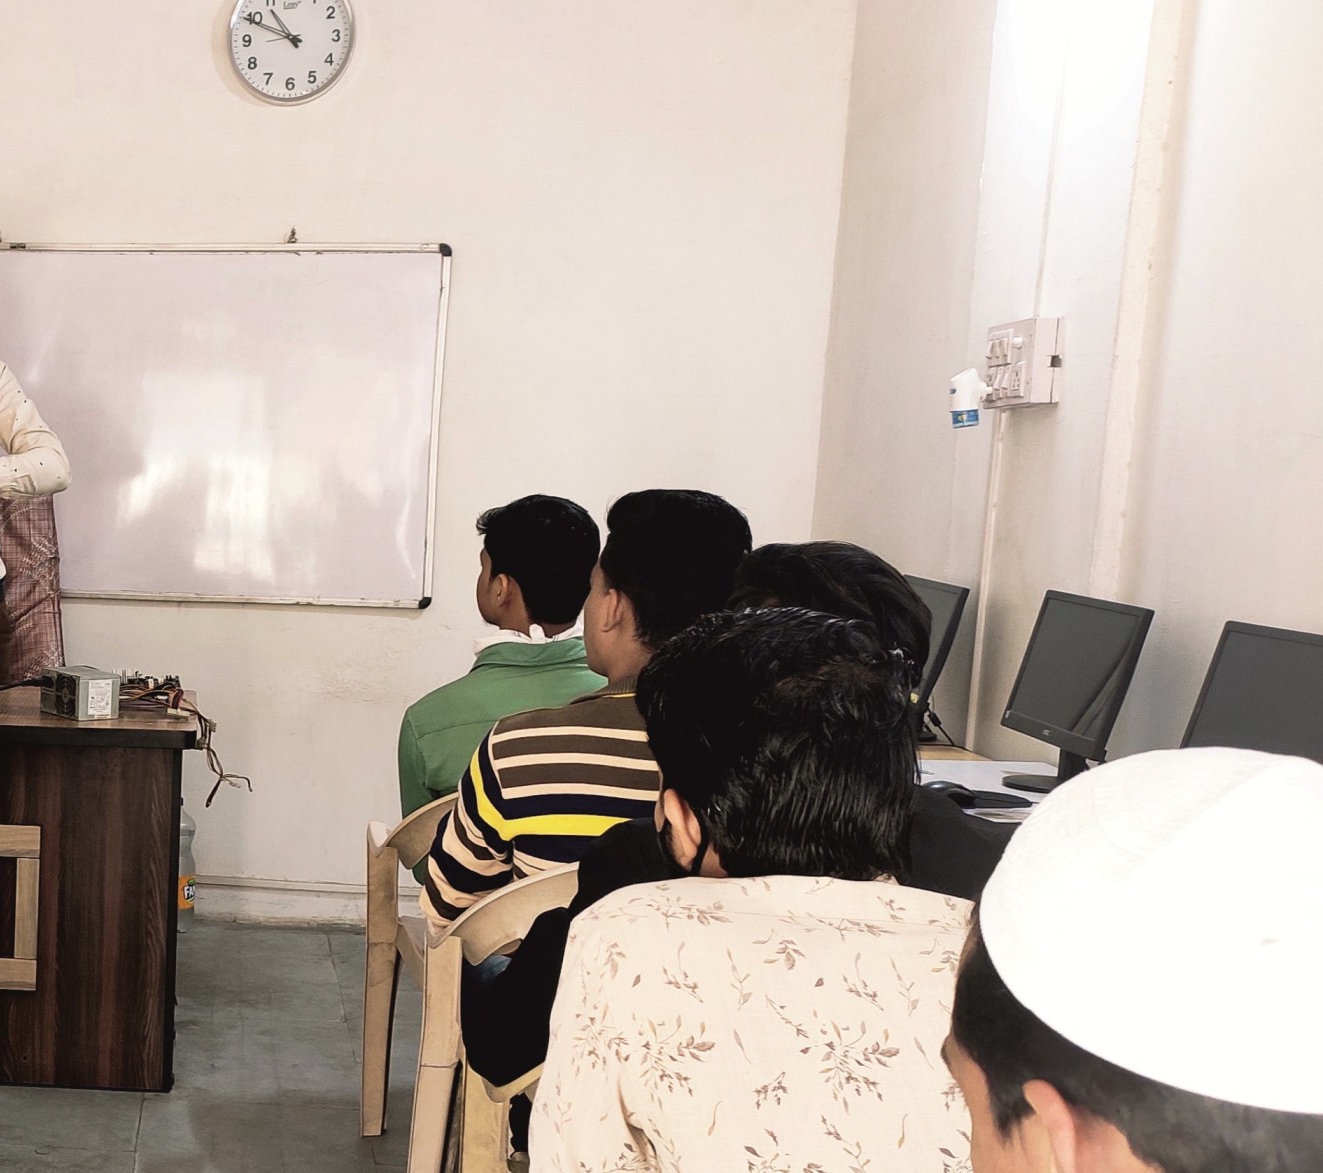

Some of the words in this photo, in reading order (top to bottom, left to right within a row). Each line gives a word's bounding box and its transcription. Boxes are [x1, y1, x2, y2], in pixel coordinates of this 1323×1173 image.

[246, 11, 263, 25] 10
[325, 5, 336, 19] 2
[242, 34, 252, 48] 9
[331, 29, 341, 43] 3
[247, 56, 257, 70] 8
[324, 53, 335, 66] 4
[263, 72, 274, 86] 7
[285, 77, 295, 91] 6
[307, 70, 317, 84] 5
